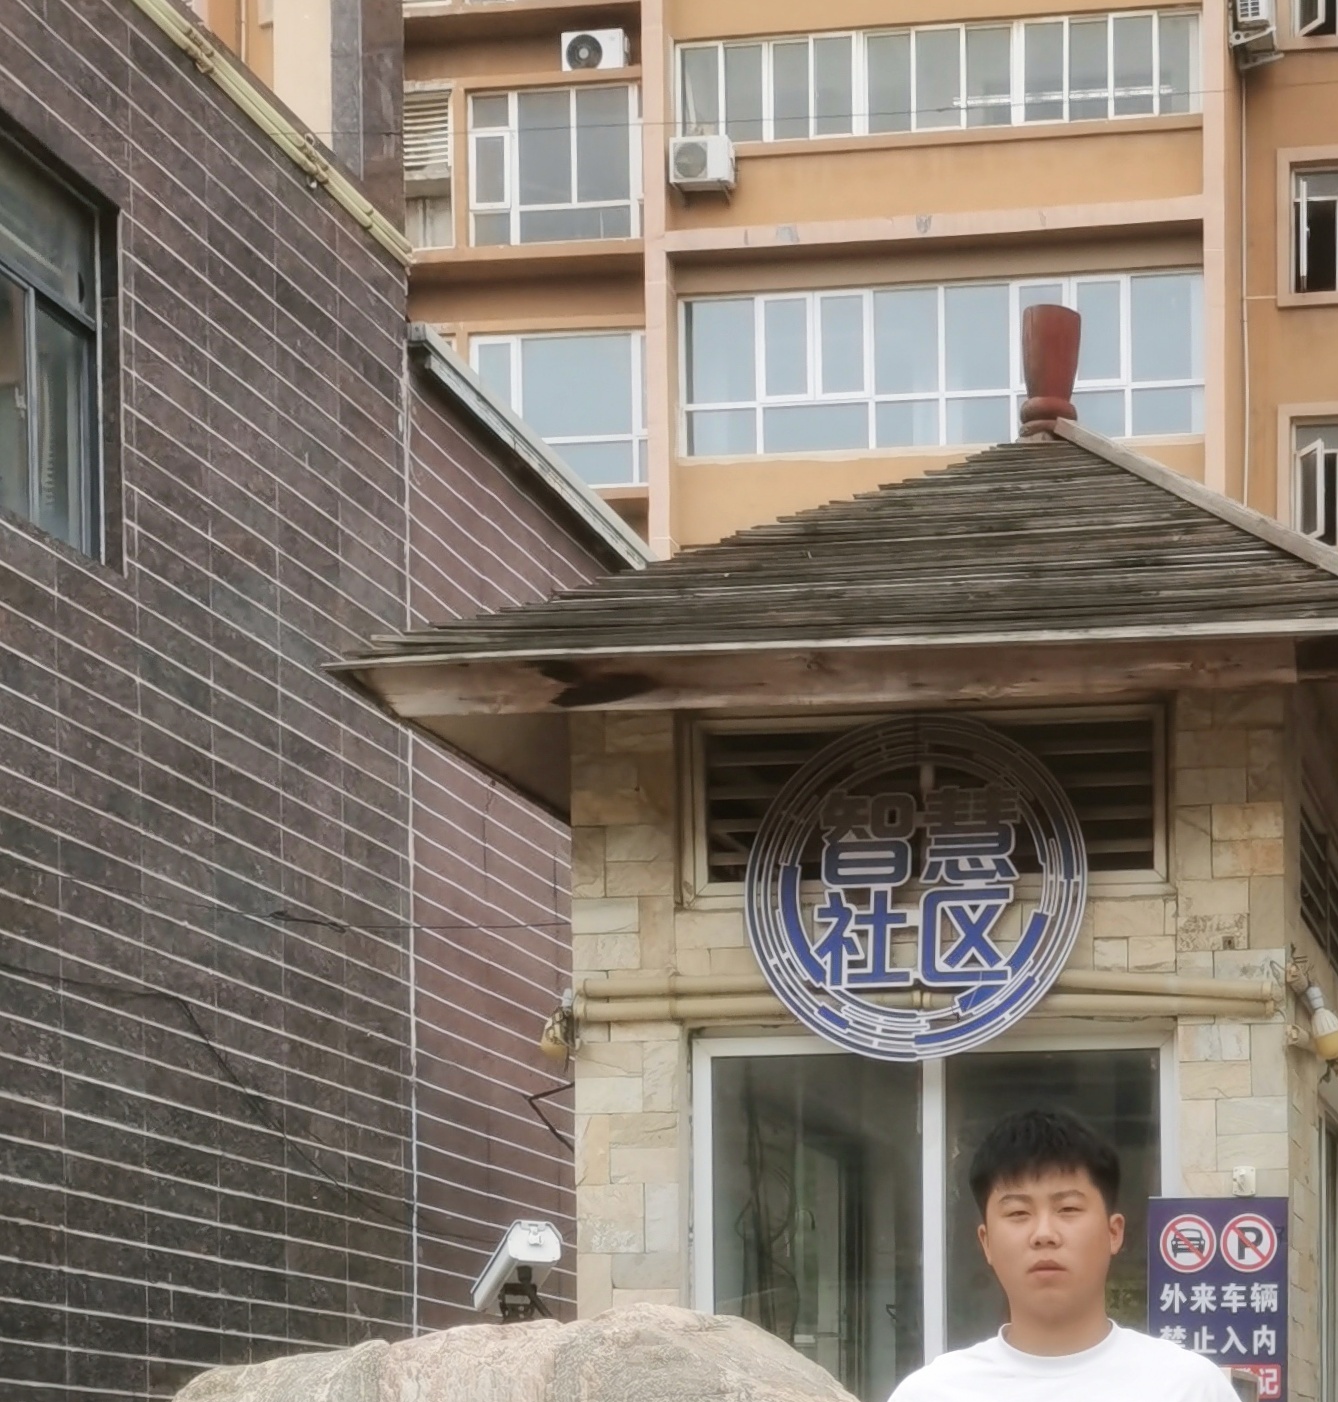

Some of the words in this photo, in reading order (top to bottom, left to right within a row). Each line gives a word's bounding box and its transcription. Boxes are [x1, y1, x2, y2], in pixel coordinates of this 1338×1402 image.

[820, 786, 1020, 886] 智慧
[810, 884, 1013, 990] 社区
[1160, 1282, 1278, 1314] 外来车辆
